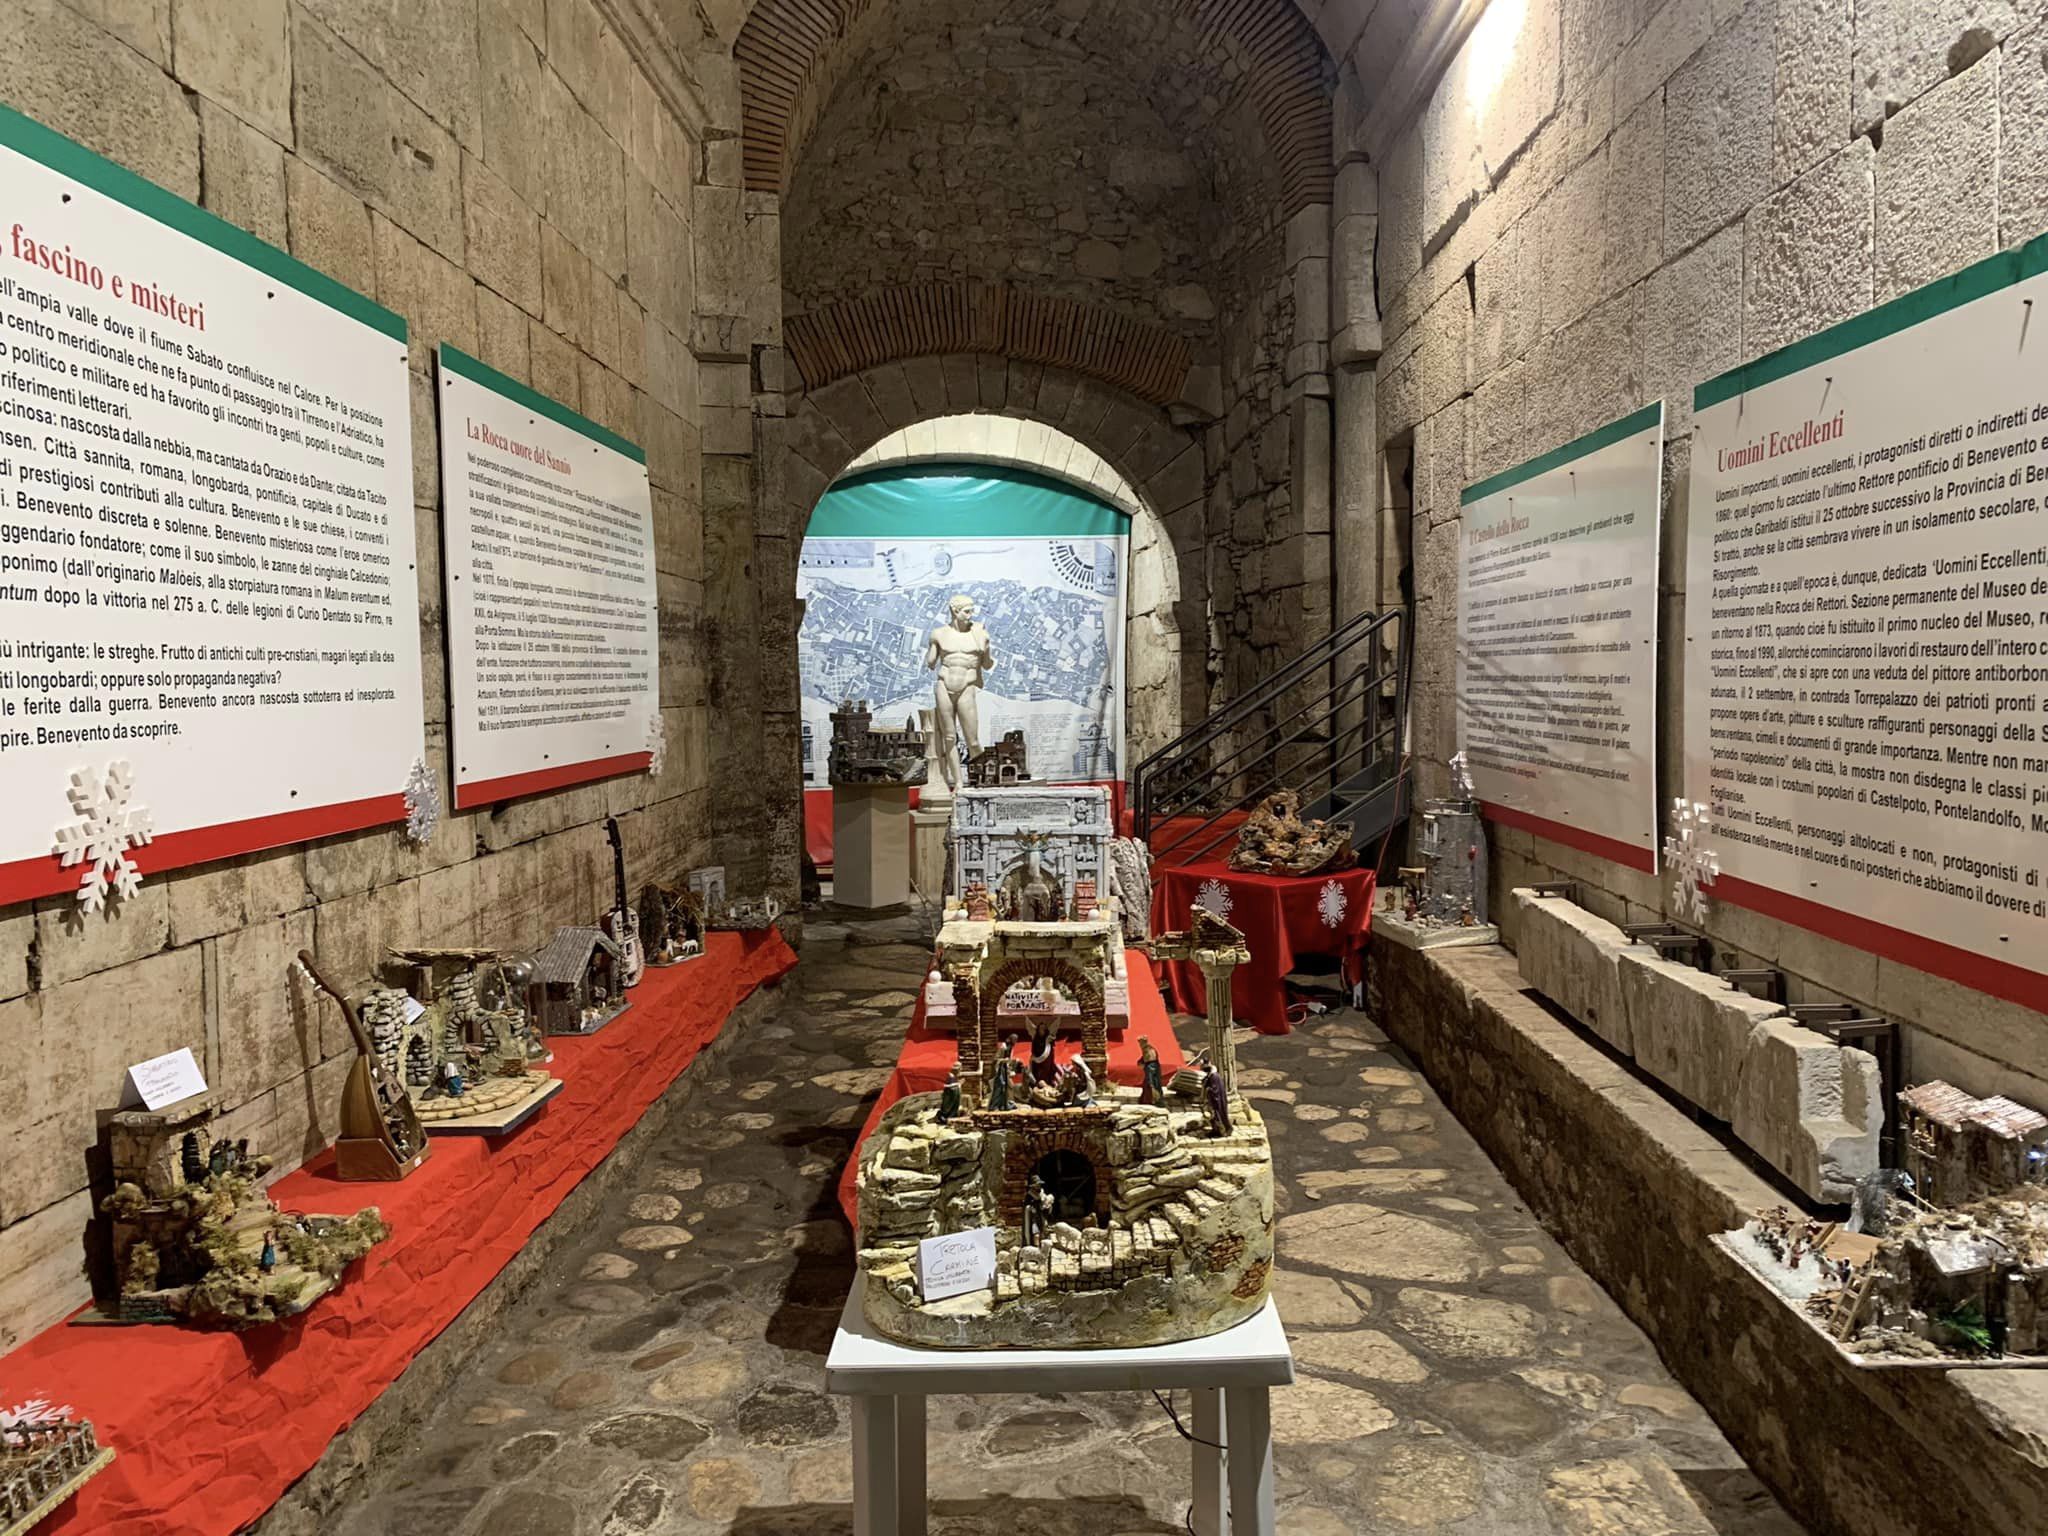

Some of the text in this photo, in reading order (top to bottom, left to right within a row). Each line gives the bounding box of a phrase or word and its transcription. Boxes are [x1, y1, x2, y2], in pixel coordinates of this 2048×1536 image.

[11, 223, 205, 331] fascino e misteri
[66, 304, 98, 327] valle
[103, 315, 134, 339] dove
[138, 326, 146, 344] il
[150, 331, 182, 356] fiume
[226, 362, 275, 389] confluisce
[7, 314, 54, 341] centro
[58, 330, 134, 366] meridionale
[137, 355, 158, 374] che
[176, 366, 187, 383] fa
[233, 389, 280, 415] passaggio
[12, 346, 66, 373] politico
[82, 366, 129, 392] militare
[168, 389, 210, 415] favorito
[1, 370, 132, 420] riferimenti letterari.
[60, 415, 120, 441] nascosta
[122, 427, 151, 448] dalla
[466, 417, 479, 440] La
[482, 423, 508, 452] Rocca
[511, 439, 533, 462] cuore
[534, 447, 545, 466] del
[1718, 410, 1843, 472] Uomini Eccellenti
[1928, 424, 1962, 448] diretti
[1977, 407, 2028, 436] indiretti
[44, 436, 77, 459] Città
[83, 449, 134, 473] sannita,
[1897, 457, 1949, 486] pontificio
[1967, 437, 2037, 467] Benevento
[19, 466, 94, 491] prestigiosi
[100, 481, 159, 503] contributi
[164, 491, 184, 508] alla
[1946, 472, 2005, 499] Provincia
[16, 491, 93, 519] Benevento
[98, 505, 148, 528] discreta
[1911, 497, 2039, 530] isolamento secolare,
[79, 530, 145, 557] fondatore;
[150, 544, 181, 559] come
[184, 544, 191, 560] il
[194, 550, 214, 563] suo
[62, 557, 156, 584] (dall'originario
[1882, 562, 1927, 581] dedicata
[44, 585, 80, 608] dopo
[102, 590, 146, 609] vittoria
[151, 595, 169, 610] nel
[173, 595, 193, 612] 275
[1891, 586, 1957, 609] permanente
[1960, 582, 1980, 600] del
[1982, 581, 2026, 598] Museo
[1877, 616, 1884, 632] il
[1887, 615, 1918, 636] primo
[1921, 613, 1960, 630] nucleo
[1963, 610, 1982, 628] del
[1986, 610, 2034, 628] Museo,
[16, 640, 243, 664] intrigante: le streghe. Frutto antichi
[1878, 638, 2037, 658] lavori restauro dell'intero
[16, 670, 282, 693] longobardi; oppure solo negativa?
[1873, 665, 1907, 680] veduta
[1911, 664, 1928, 680] del
[1932, 664, 1971, 684] pittore
[2, 698, 15, 716] le
[23, 696, 61, 715] ferite
[69, 695, 101, 713] dalla
[108, 698, 152, 716] guerra.
[158, 693, 217, 709] Benevento
[1923, 691, 1940, 708] dei
[1946, 692, 1989, 712] patrioti
[1995, 693, 2036, 714] pronti
[37, 725, 110, 744] Benevento
[1929, 722, 2035, 743] personaggi della
[1946, 746, 1988, 767] Mentre
[1993, 755, 2018, 770] non
[1889, 770, 2026, 800] non disdegna le classi
[1934, 799, 2025, 832] Pontelandolfo,
[1912, 848, 1937, 867] non,
[1943, 855, 2018, 882] protagonisti
[1902, 869, 1922, 887] che
[1923, 874, 1974, 900] abbiamo
[1985, 888, 2030, 914] dovere
